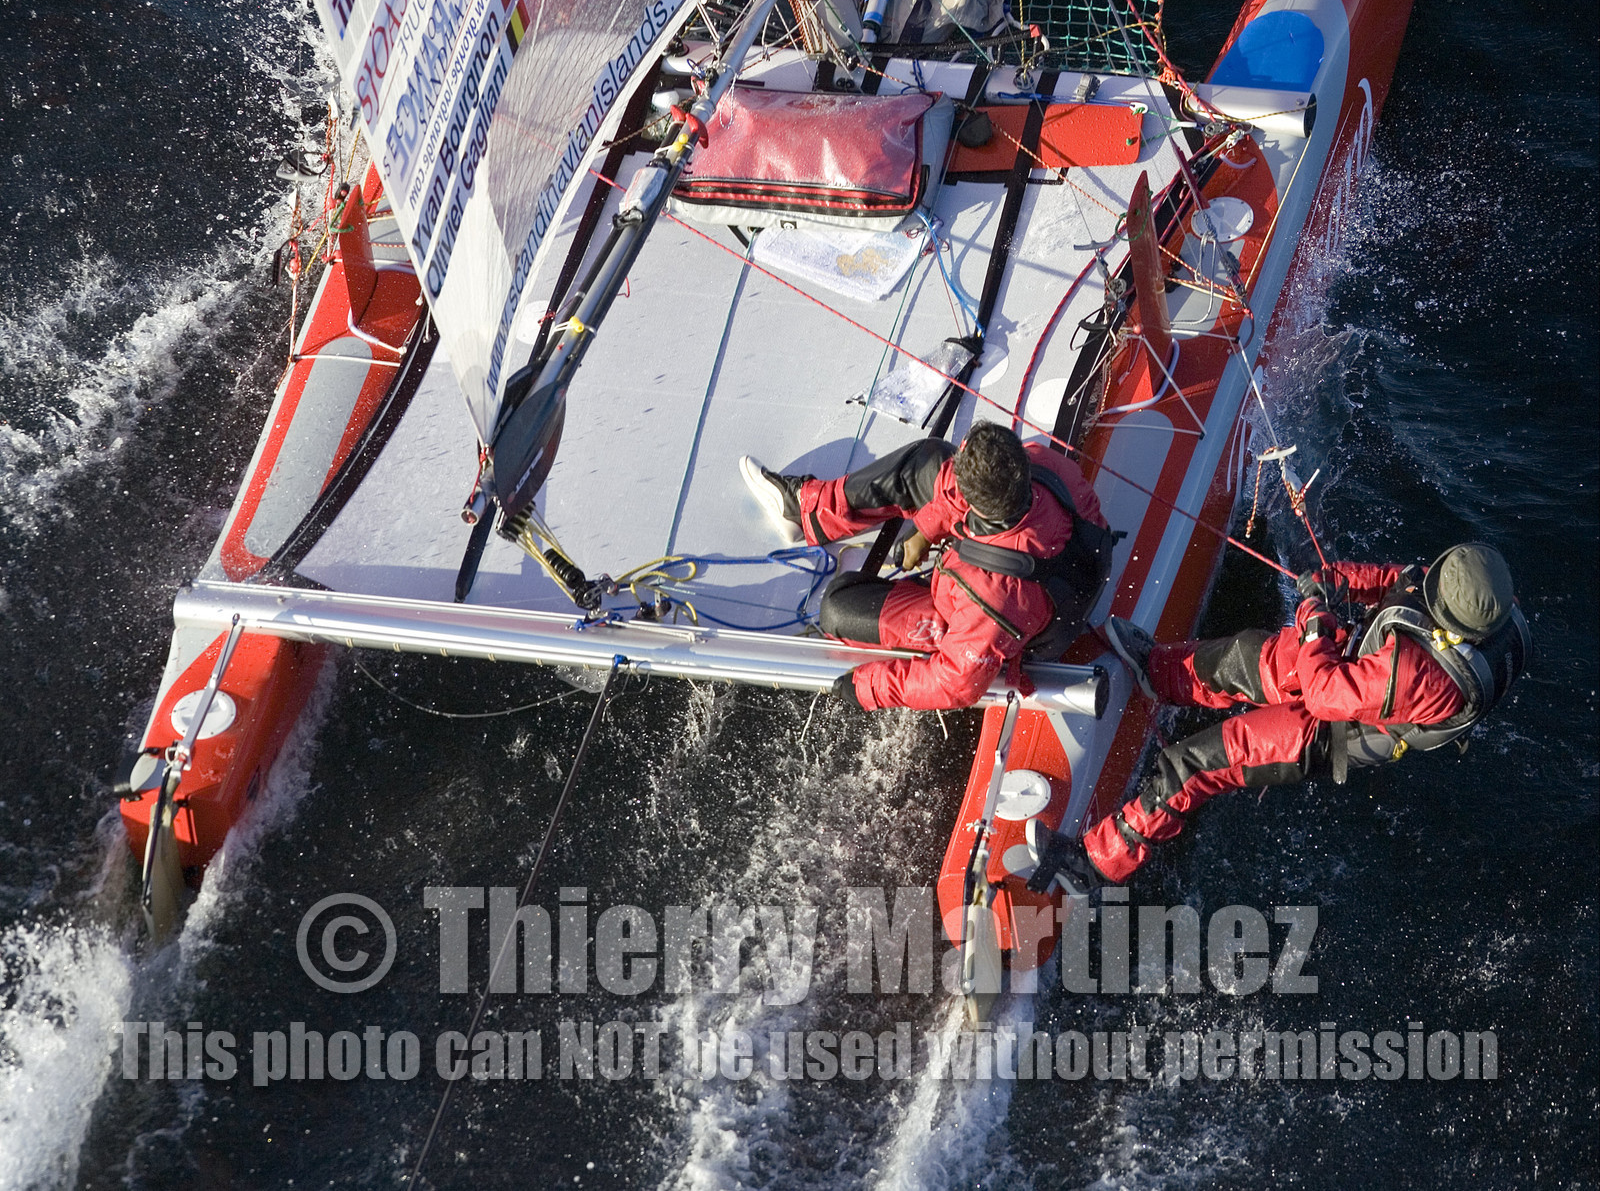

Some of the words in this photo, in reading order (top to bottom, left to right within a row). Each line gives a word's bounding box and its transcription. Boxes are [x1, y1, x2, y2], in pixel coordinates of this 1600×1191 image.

[411, 188, 446, 258] Yvan
[439, 11, 499, 179] Bourgnon
[427, 187, 462, 298] Olivier
[459, 51, 508, 190] Gagliani
